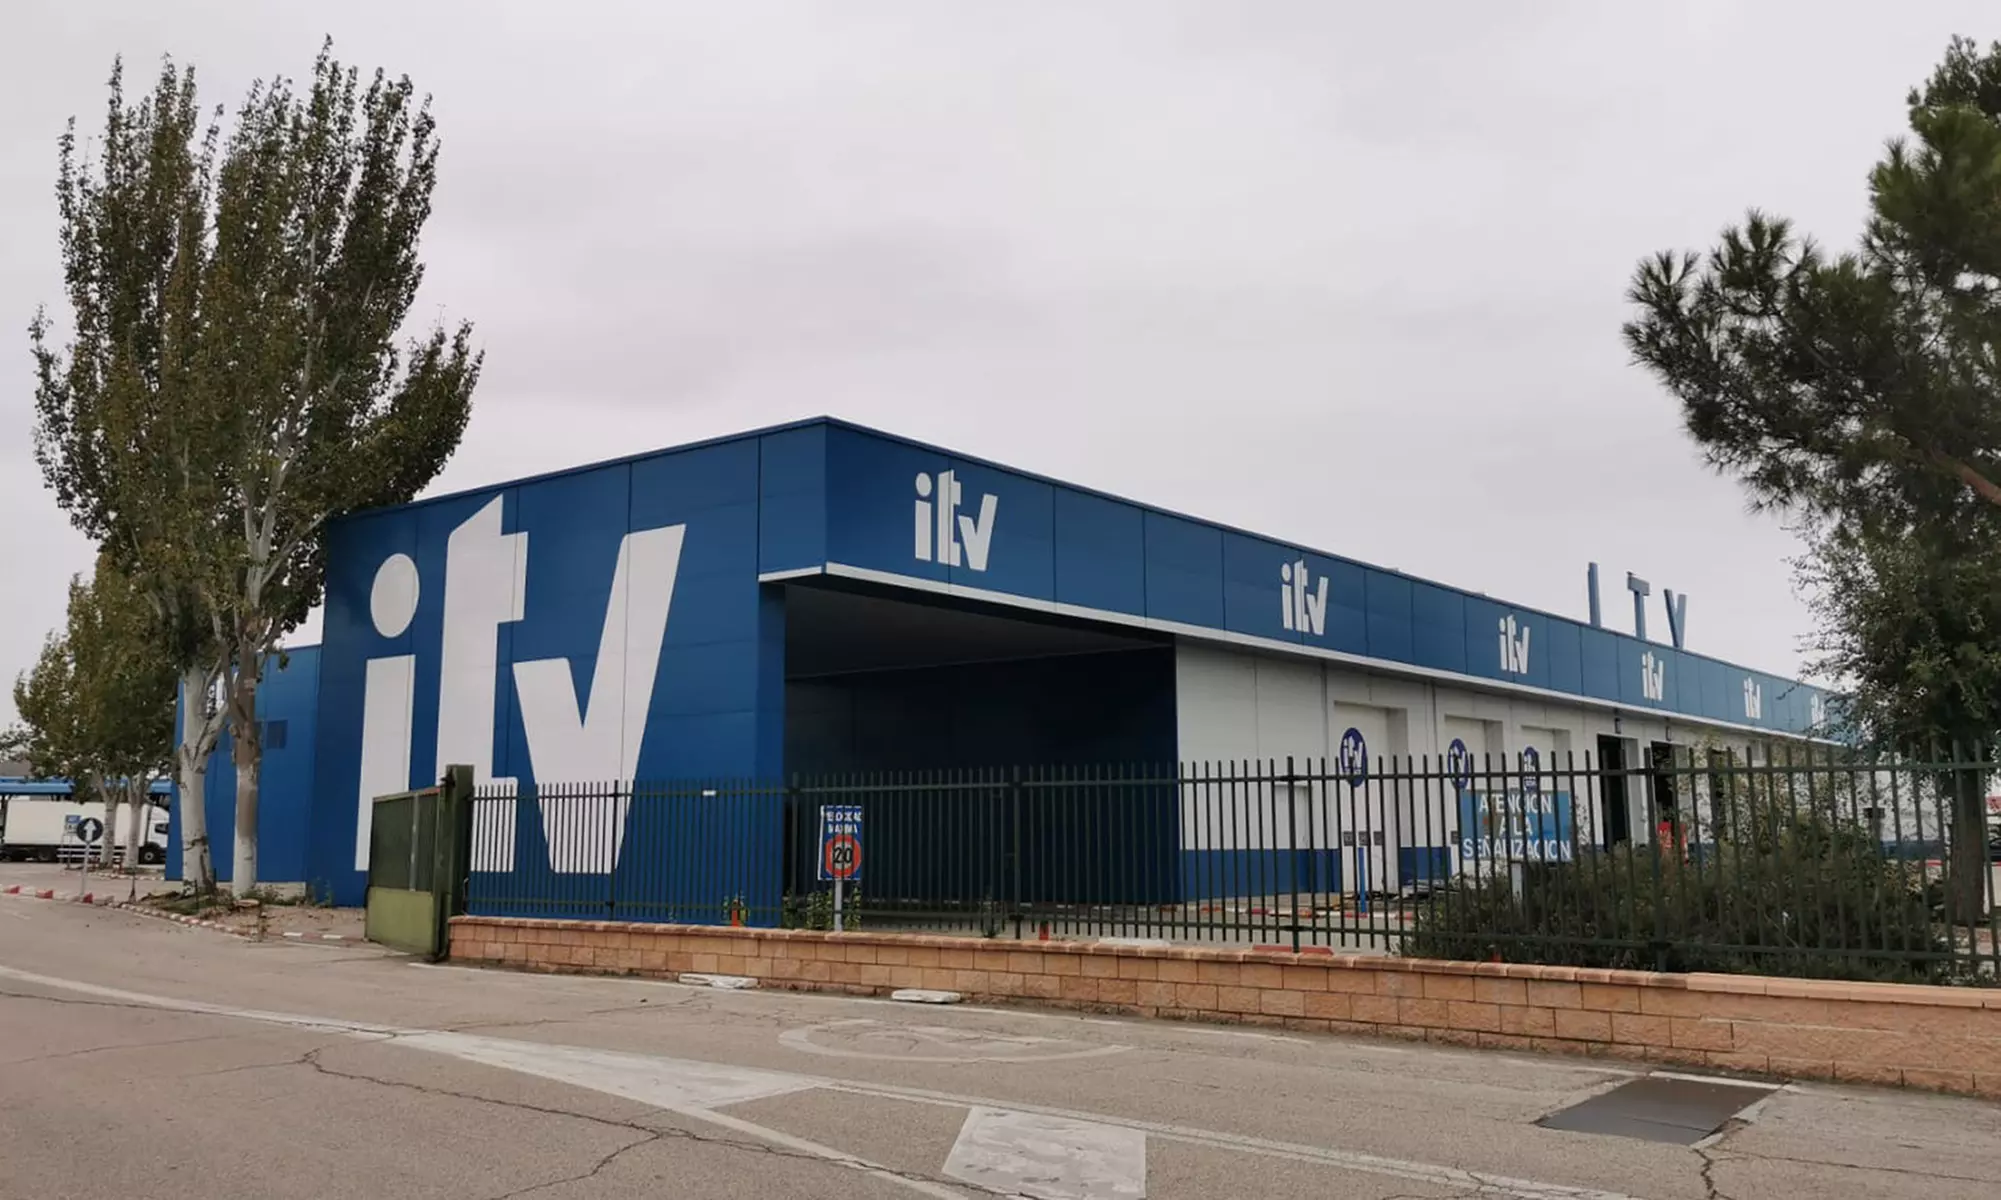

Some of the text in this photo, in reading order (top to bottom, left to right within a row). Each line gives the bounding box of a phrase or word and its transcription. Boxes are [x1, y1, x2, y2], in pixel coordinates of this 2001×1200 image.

[915, 469, 998, 571] itv
[1281, 559, 1328, 636] itv
[1588, 562, 1687, 650] ITV
[1499, 614, 1530, 674] itv
[1642, 651, 1664, 701] itv
[355, 493, 686, 873] itv
[1743, 677, 1761, 720] itv
[833, 847, 853, 863] 20
